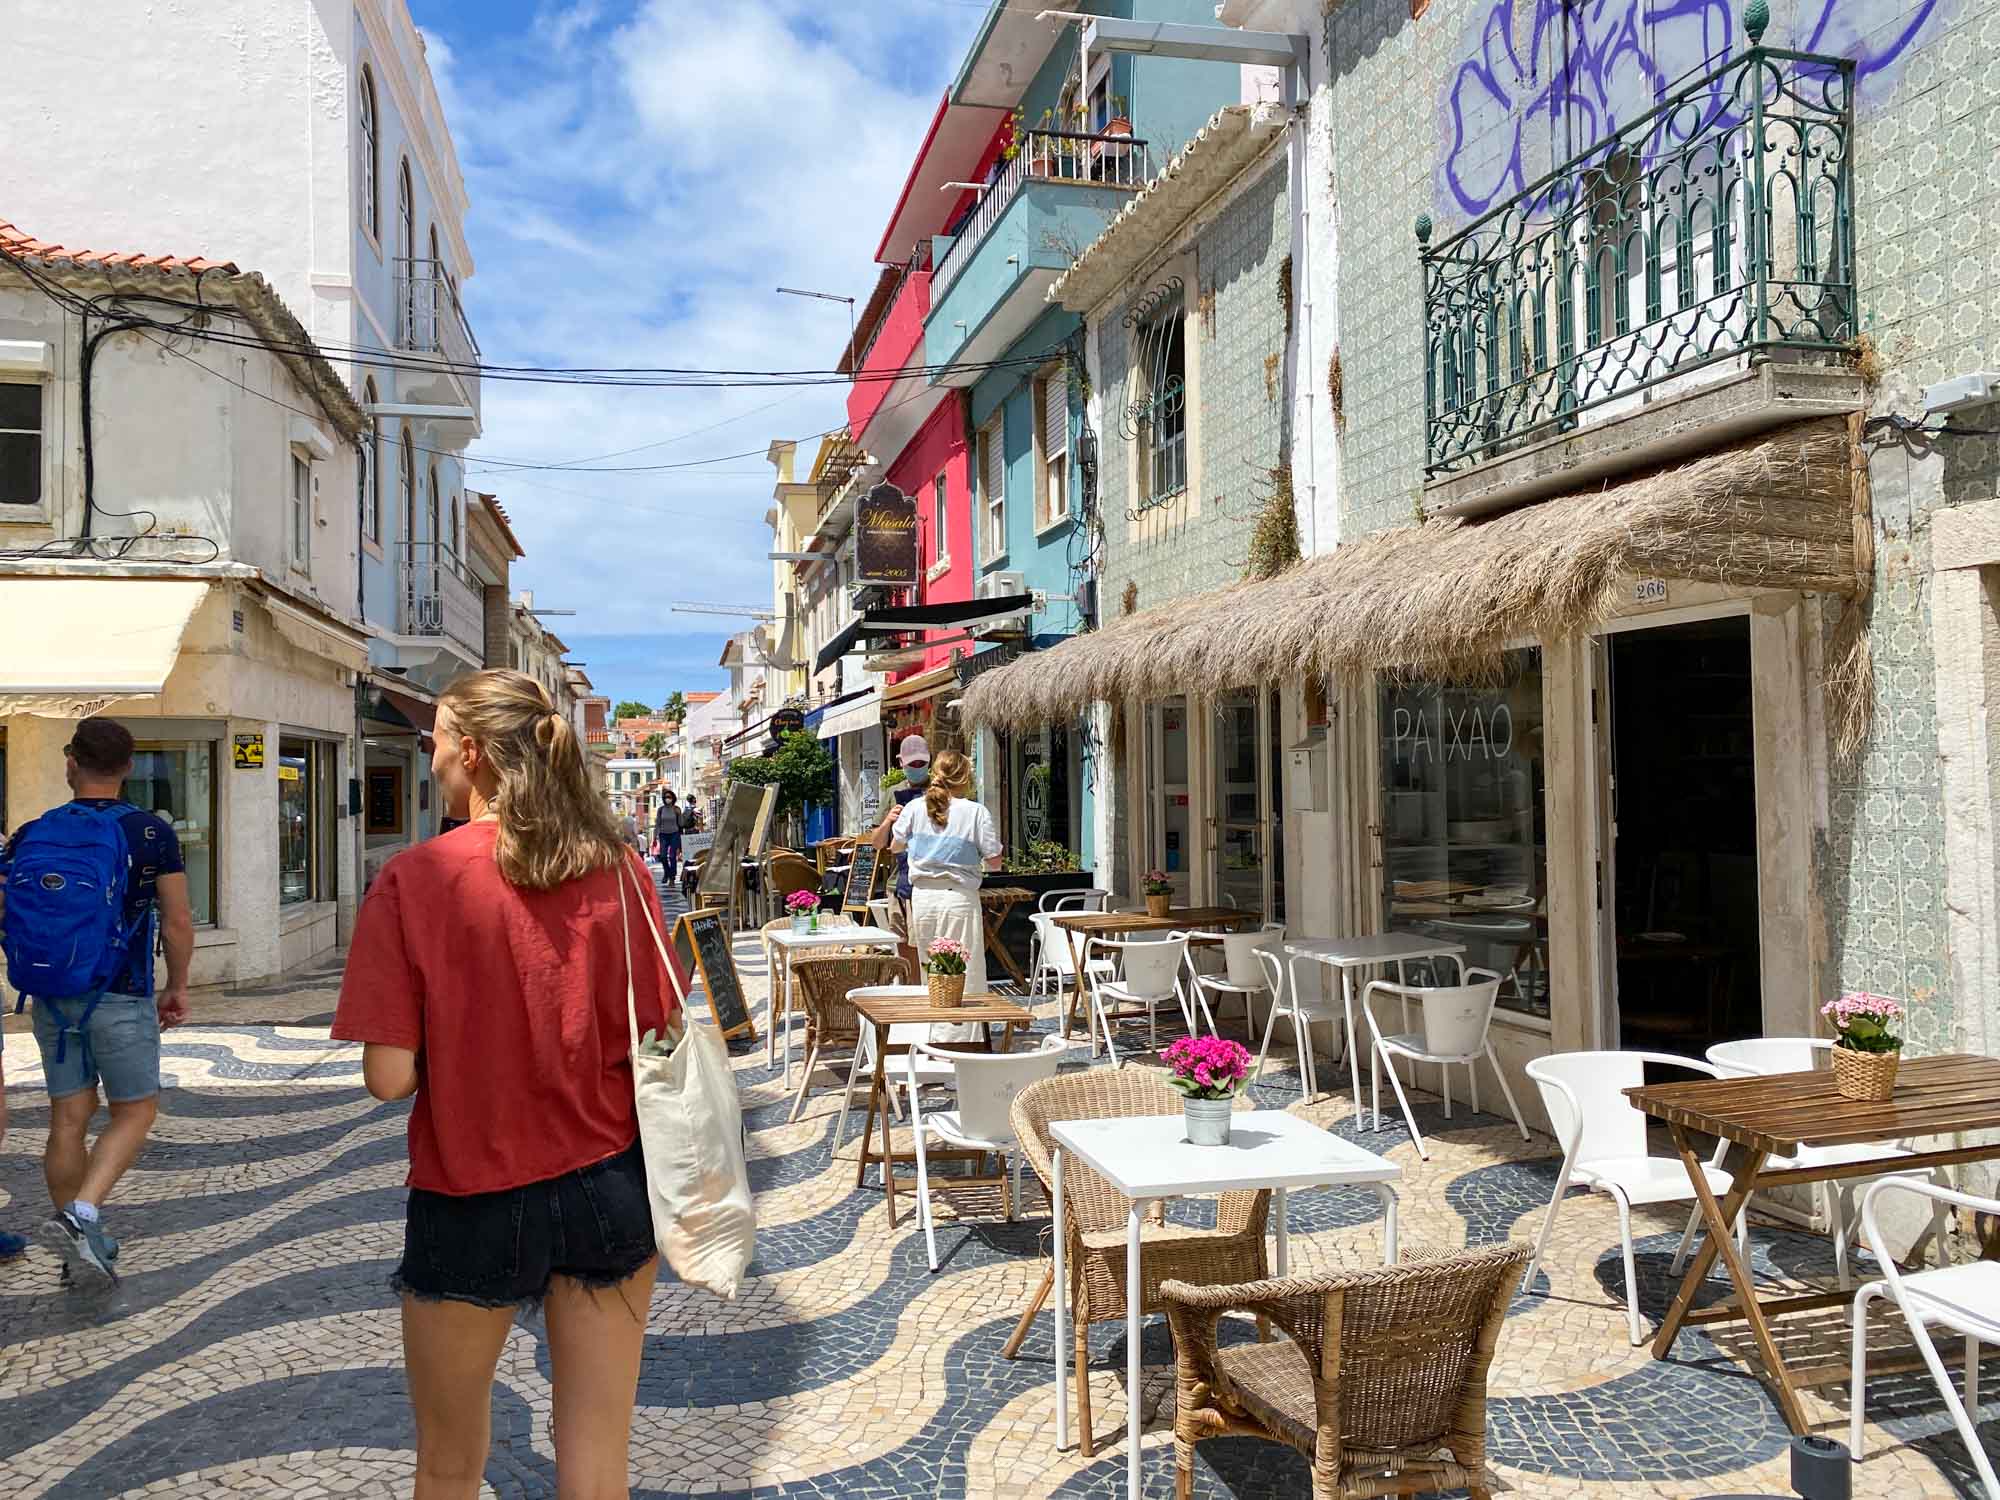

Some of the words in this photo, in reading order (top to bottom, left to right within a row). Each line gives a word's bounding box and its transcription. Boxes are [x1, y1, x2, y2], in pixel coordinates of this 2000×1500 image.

[860, 509, 915, 528] Masala
[883, 568, 908, 577] 2005
[1637, 580, 1665, 599] 266
